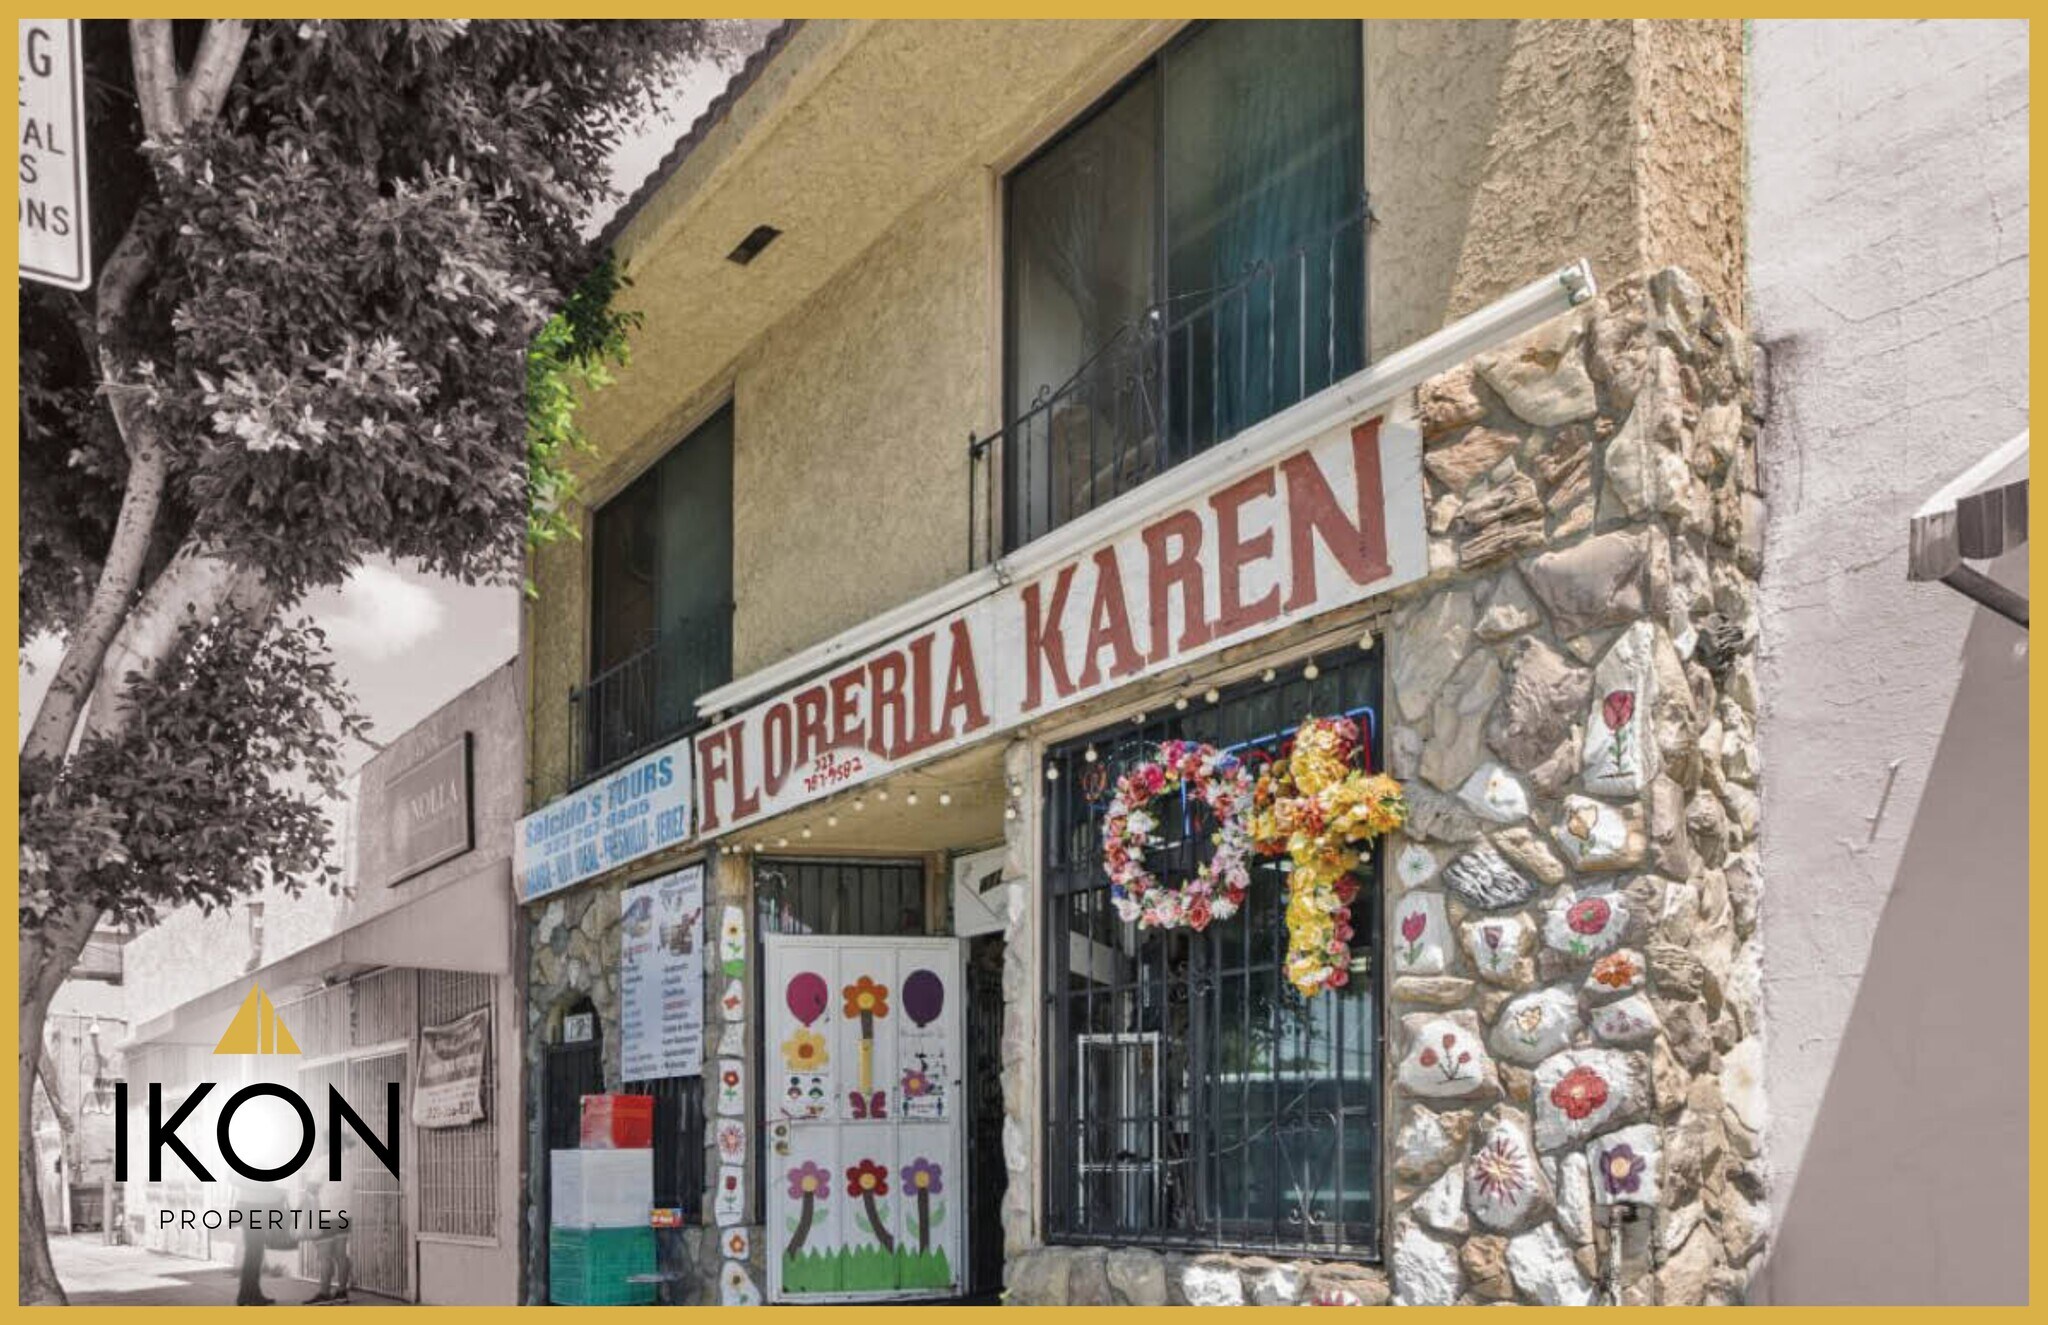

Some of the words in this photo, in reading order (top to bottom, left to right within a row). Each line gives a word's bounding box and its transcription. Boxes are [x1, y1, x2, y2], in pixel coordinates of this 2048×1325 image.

[19, 198, 70, 236] NS
[698, 617, 990, 833] FLORERIA
[1021, 417, 1394, 712] KAREN
[606, 756, 674, 809] TOURS
